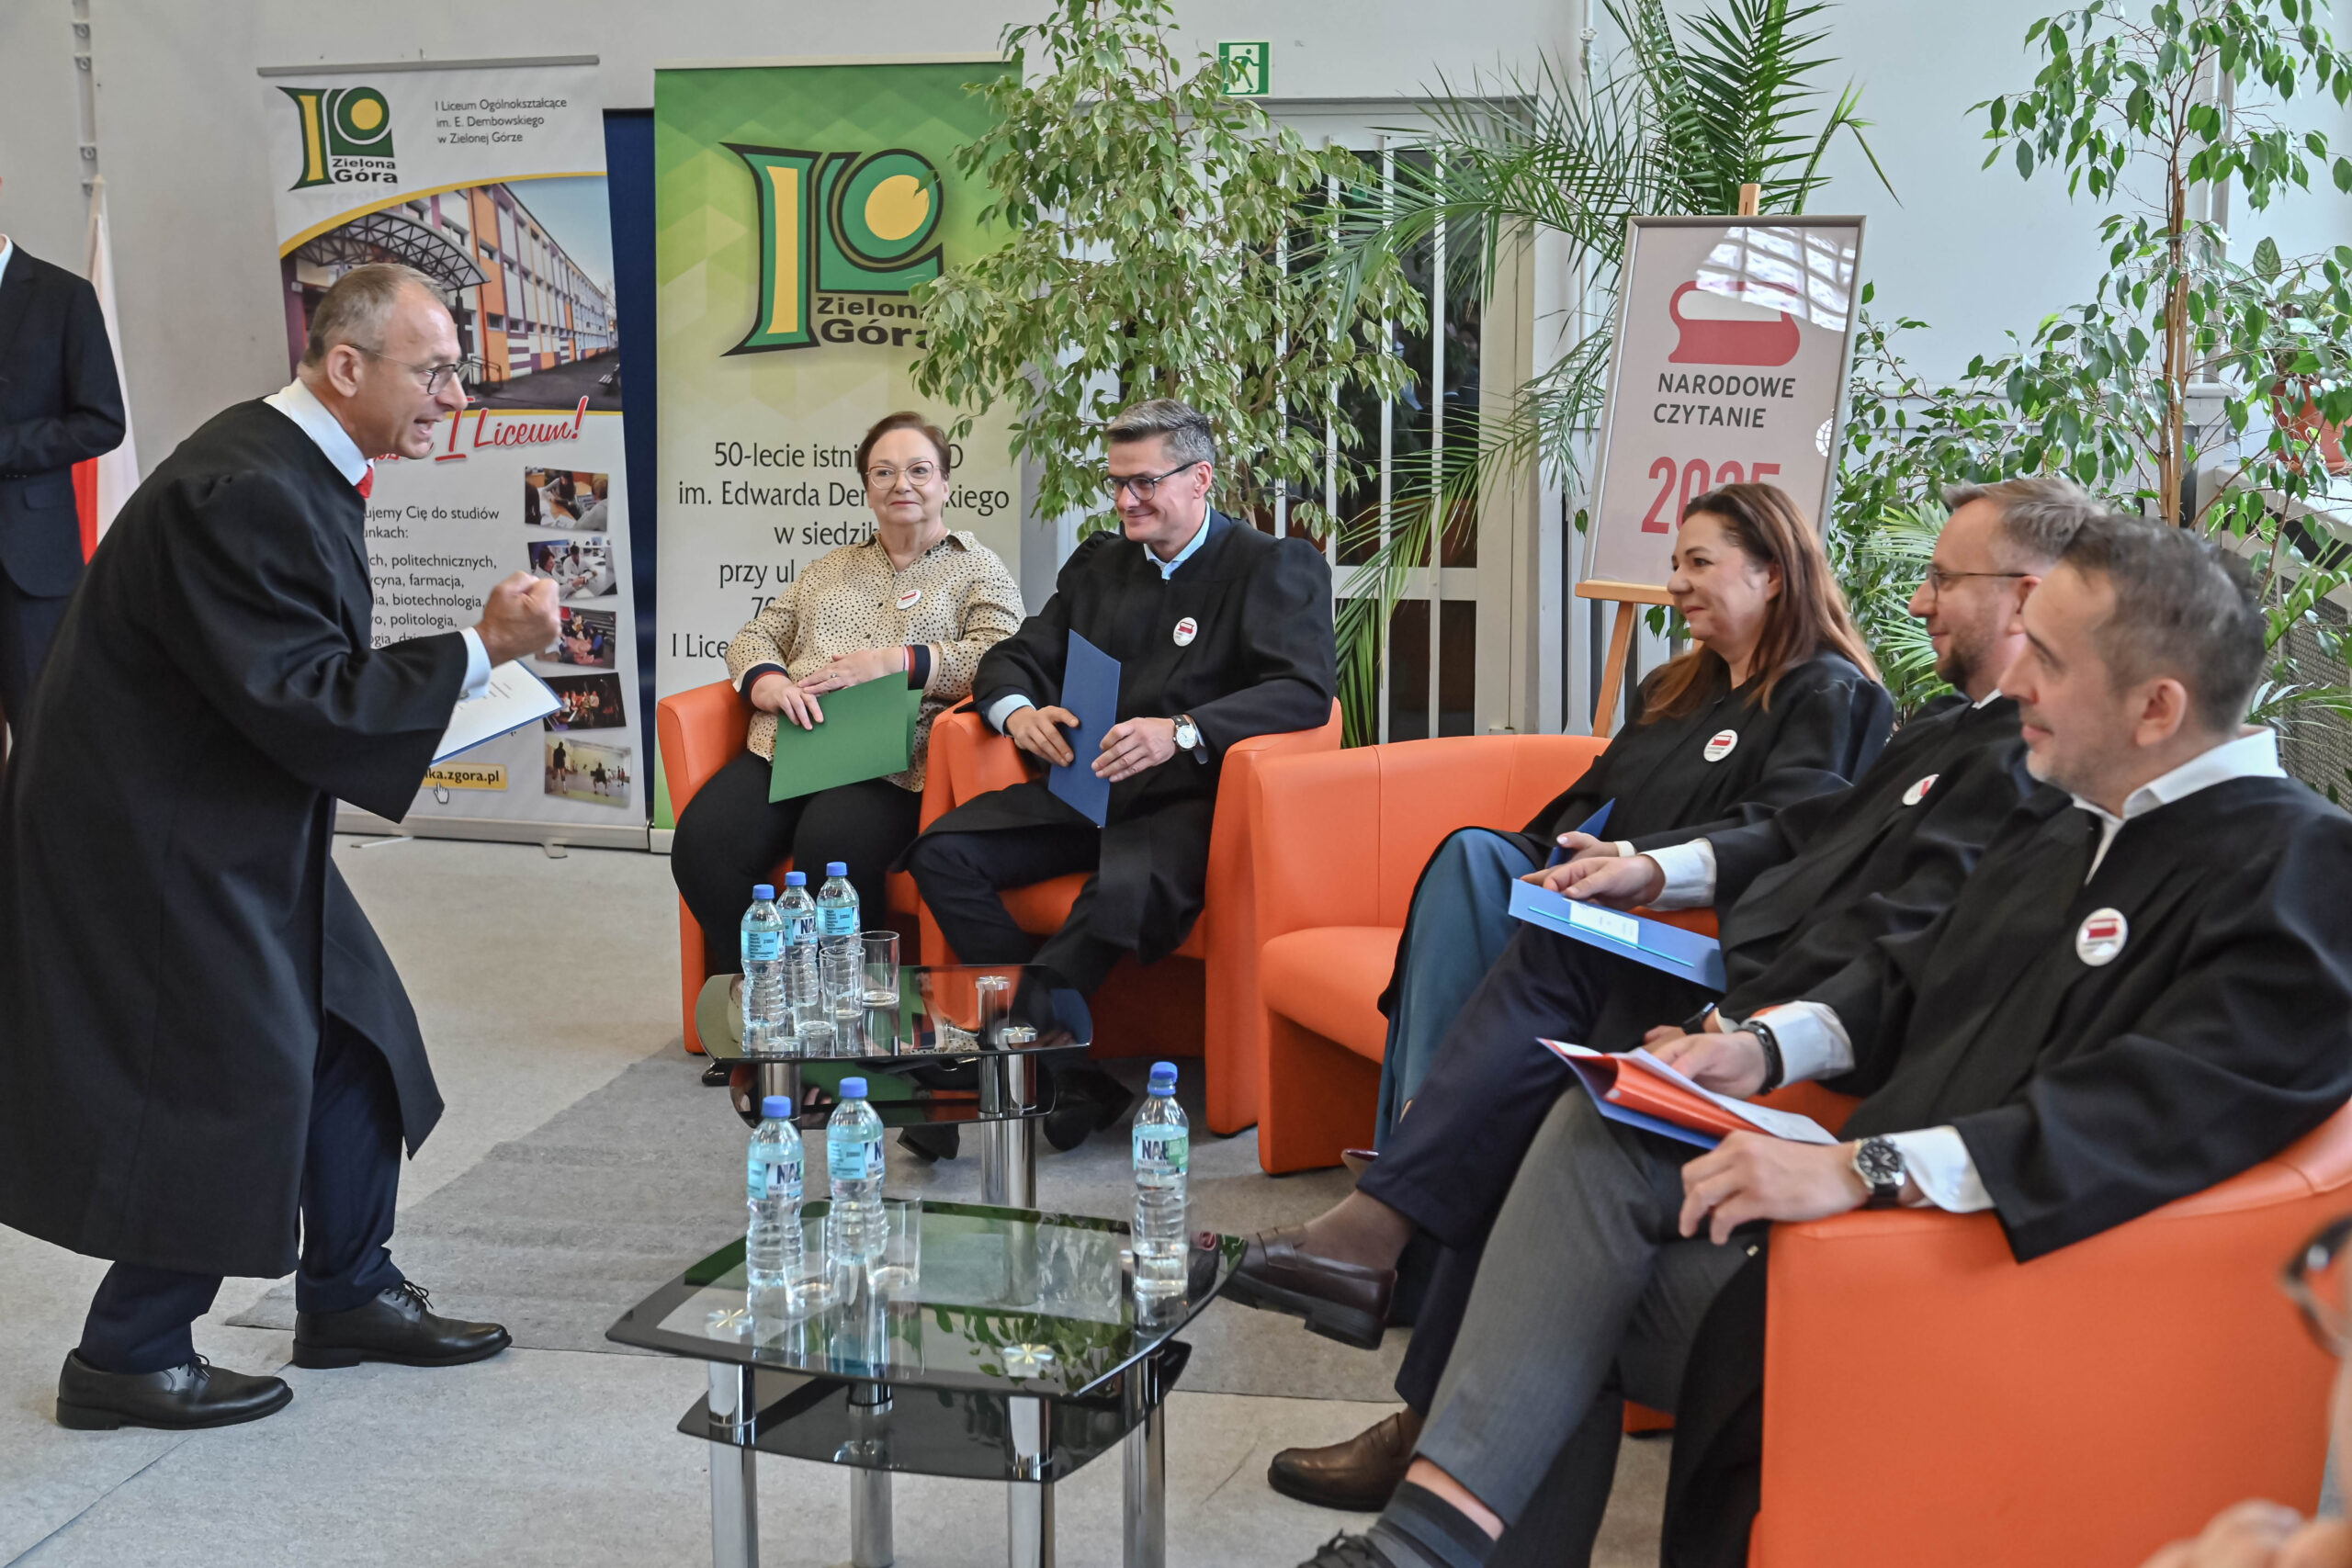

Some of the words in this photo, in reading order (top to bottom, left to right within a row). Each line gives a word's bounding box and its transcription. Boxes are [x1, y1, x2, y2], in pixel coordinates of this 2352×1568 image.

[441, 100, 477, 111] Liceum
[479, 97, 567, 112] Ogólnokształcące
[436, 118, 452, 128] im.
[454, 117, 464, 128] E.
[467, 115, 545, 129] Dembowskiego
[449, 133, 490, 145] Zielonej
[492, 131, 523, 143] Górze
[332, 158, 396, 170] Zielona
[334, 168, 398, 184] Góra
[1657, 373, 1795, 398] NARODOWE
[473, 395, 589, 448] Liceum!
[1654, 403, 1766, 428] CZYTANIE
[715, 442, 805, 467] 50-lecie
[814, 444, 858, 467] istni
[679, 481, 712, 504] im.
[722, 481, 820, 506] Edwarda
[1641, 457, 1781, 534] 20
[406, 505, 427, 521] Cię
[432, 506, 447, 520] do
[450, 506, 499, 520] studiów
[774, 526, 795, 545] w
[391, 554, 497, 571] politechnicznych,
[410, 573, 464, 590] farmacja,
[719, 564, 768, 589] przy
[392, 593, 486, 610] biotechnologia,
[390, 614, 458, 629] politologia,
[672, 633, 677, 657] I
[686, 634, 729, 658] Lice
